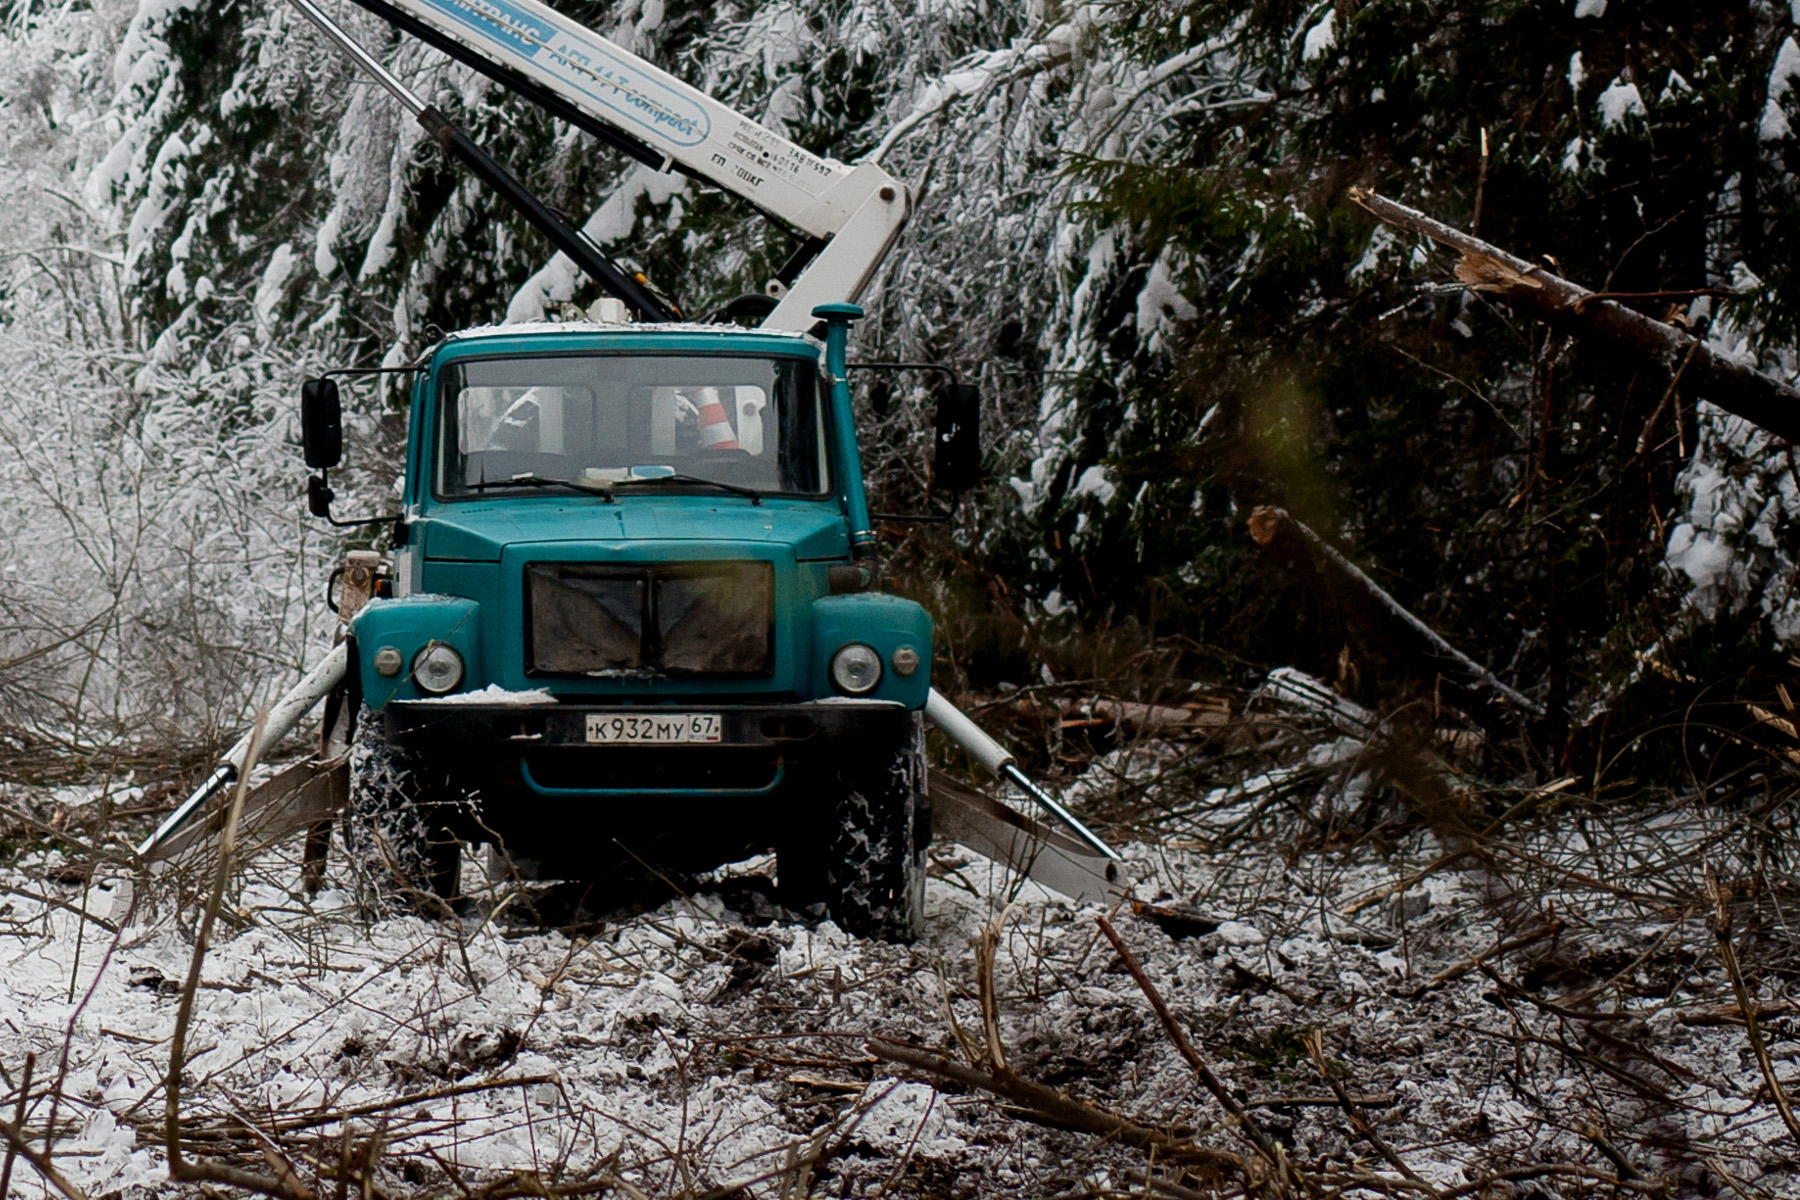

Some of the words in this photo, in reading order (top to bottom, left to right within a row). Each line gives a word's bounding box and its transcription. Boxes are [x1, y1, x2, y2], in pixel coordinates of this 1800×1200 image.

[625, 90, 698, 137] compact
[595, 718, 684, 739] К932МУ
[691, 717, 713, 733] 67
